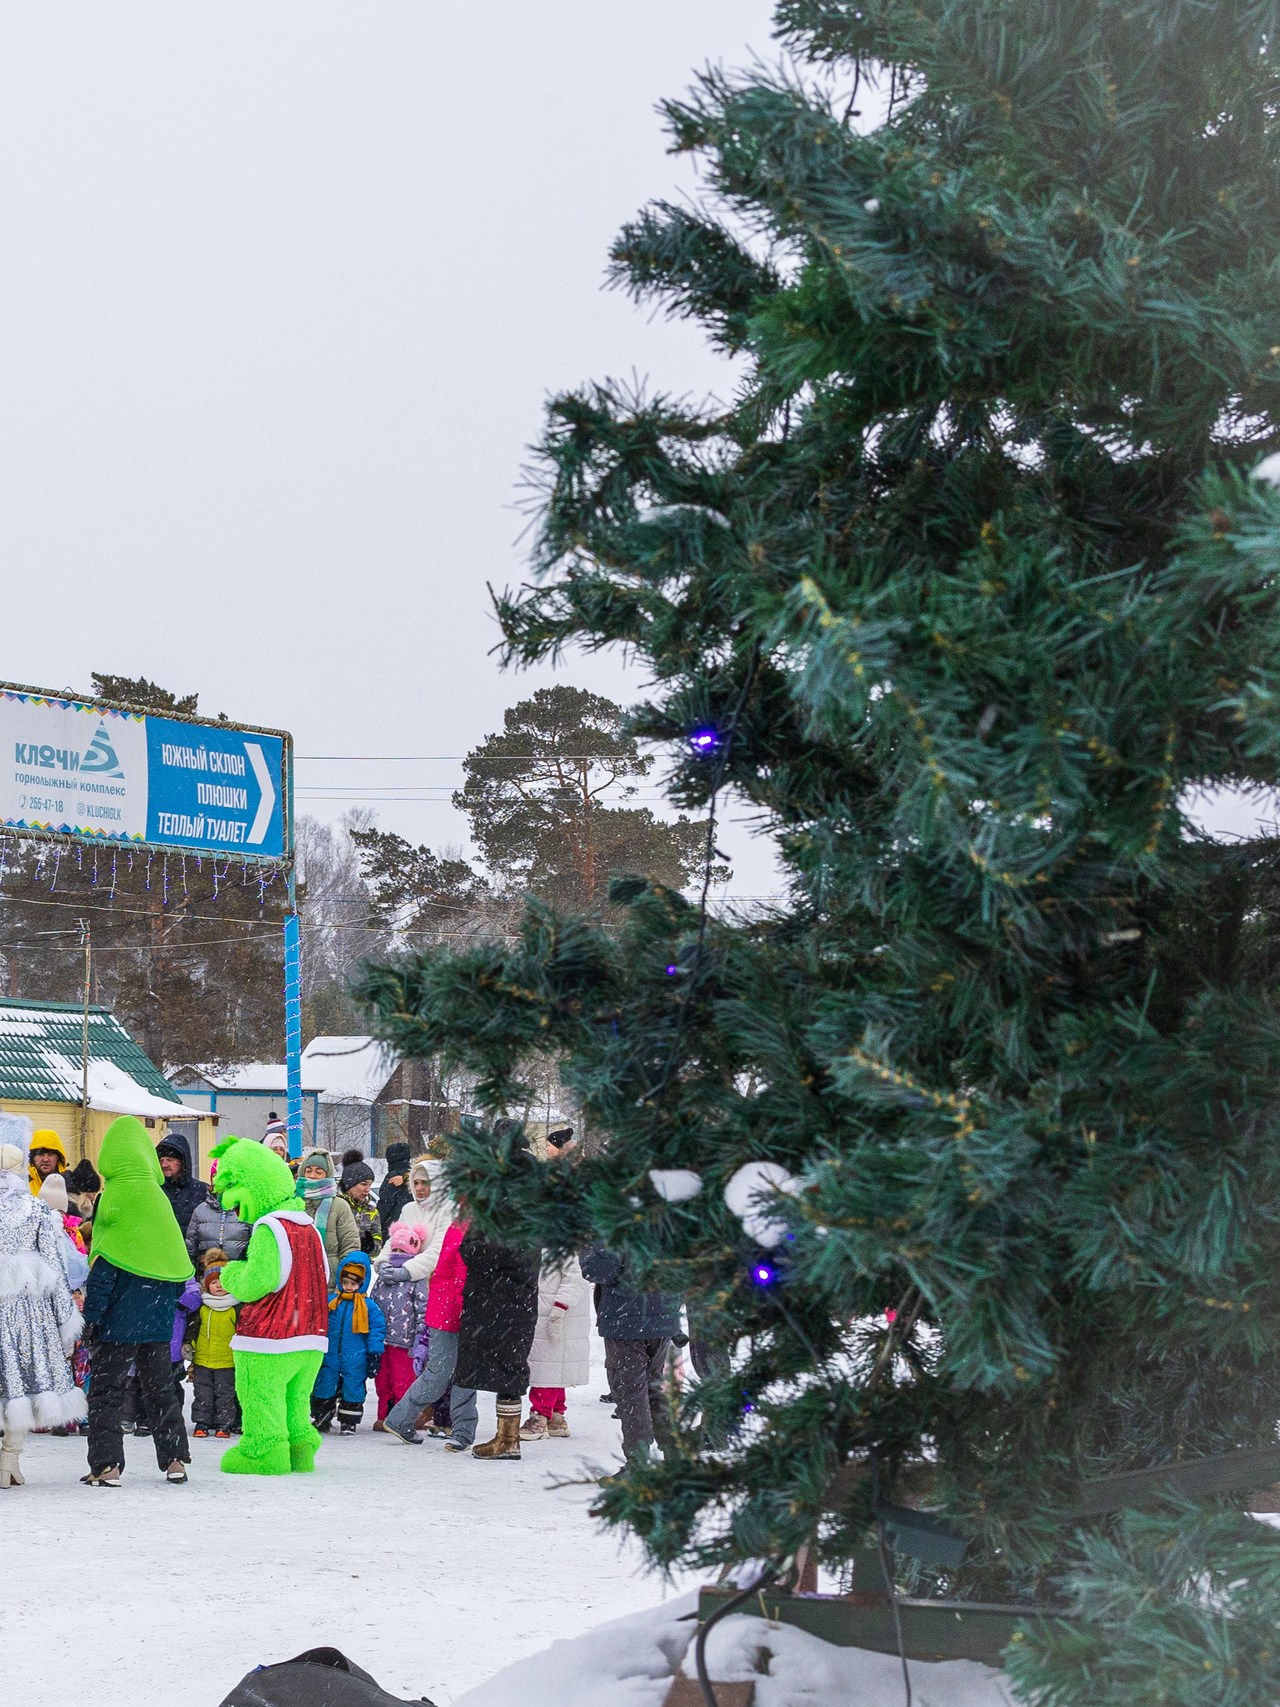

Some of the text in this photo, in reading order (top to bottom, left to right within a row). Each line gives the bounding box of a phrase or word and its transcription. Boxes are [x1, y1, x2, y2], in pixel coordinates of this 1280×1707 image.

[162, 743, 246, 777] ЮЖНЫЙ СКЛОН
[14, 772, 126, 797] горнолыжный комплекс
[197, 782, 248, 810] ПЛЮШКИ
[29, 796, 64, 813] 255-47-18
[158, 812, 248, 844] ТЕПЛЫЙ ТУАЛЕТ
